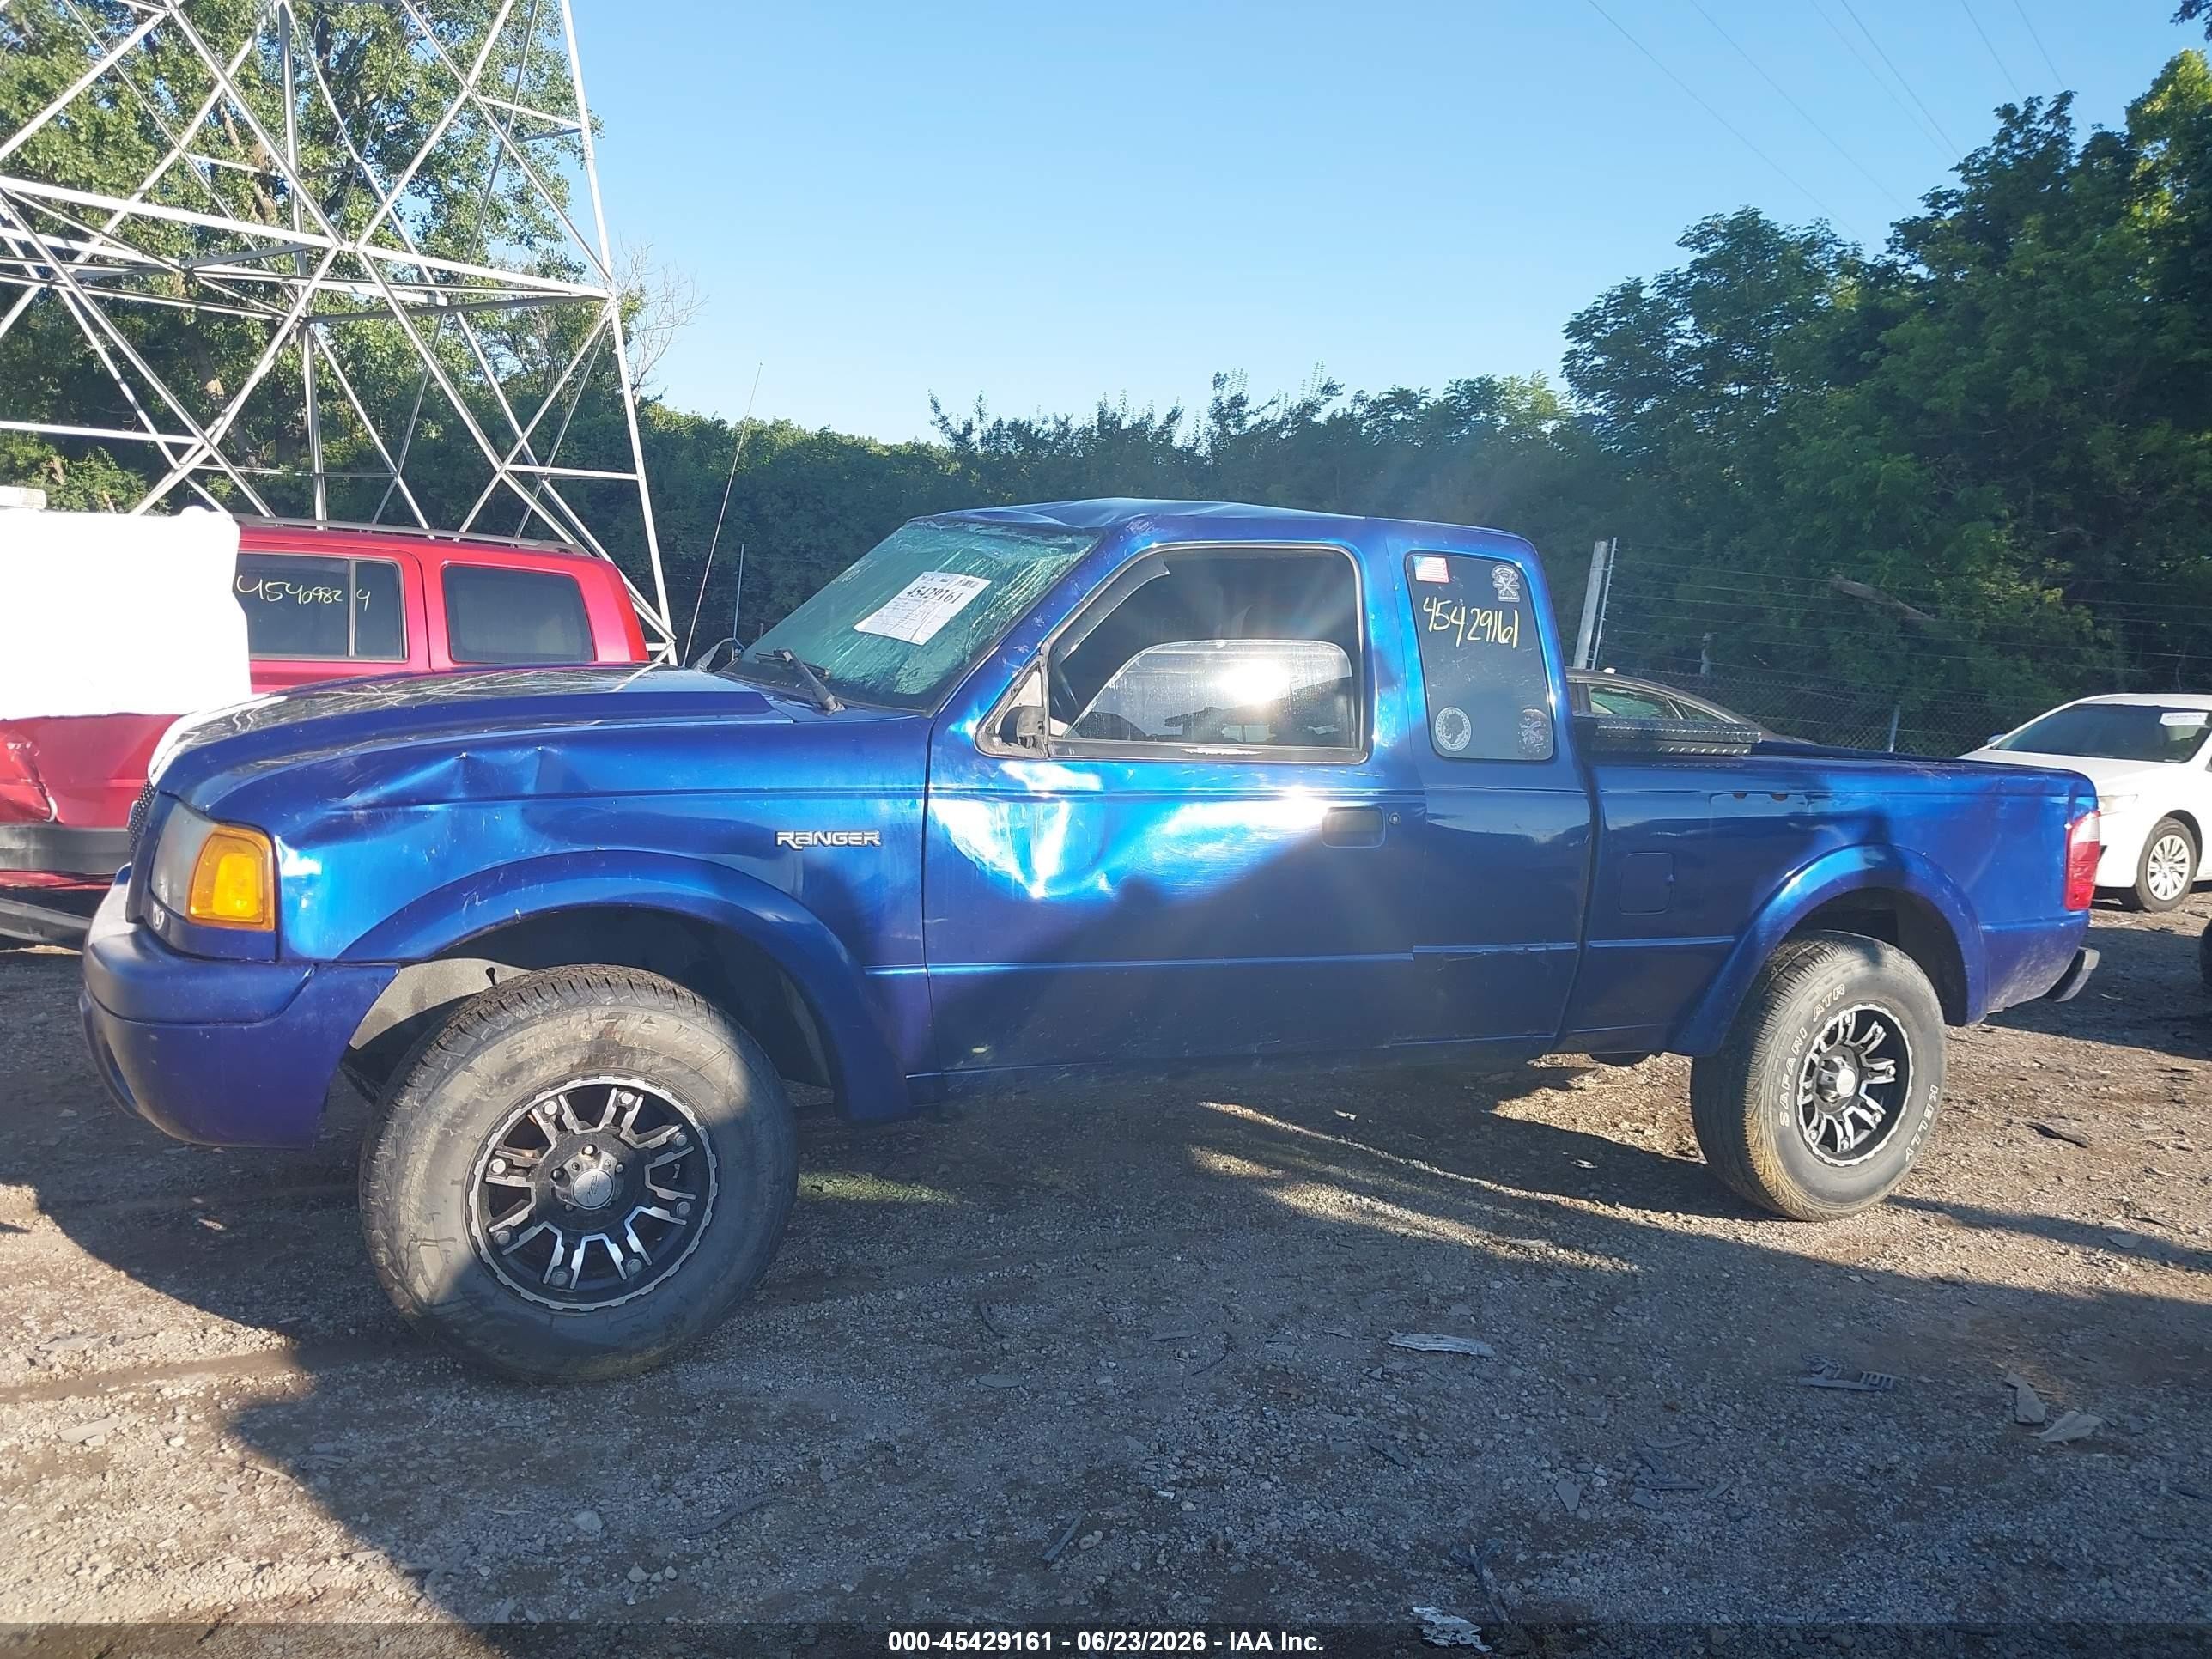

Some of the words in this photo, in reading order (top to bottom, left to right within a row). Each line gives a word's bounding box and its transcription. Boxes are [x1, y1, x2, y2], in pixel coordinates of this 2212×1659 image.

[907, 586, 963, 604] 45429161
[1423, 596, 1519, 648] 45429161
[1779, 1026, 1808, 1127] SAFARI
[1813, 983, 1845, 1022] ATR
[1905, 1084, 1939, 1162] KELLY
